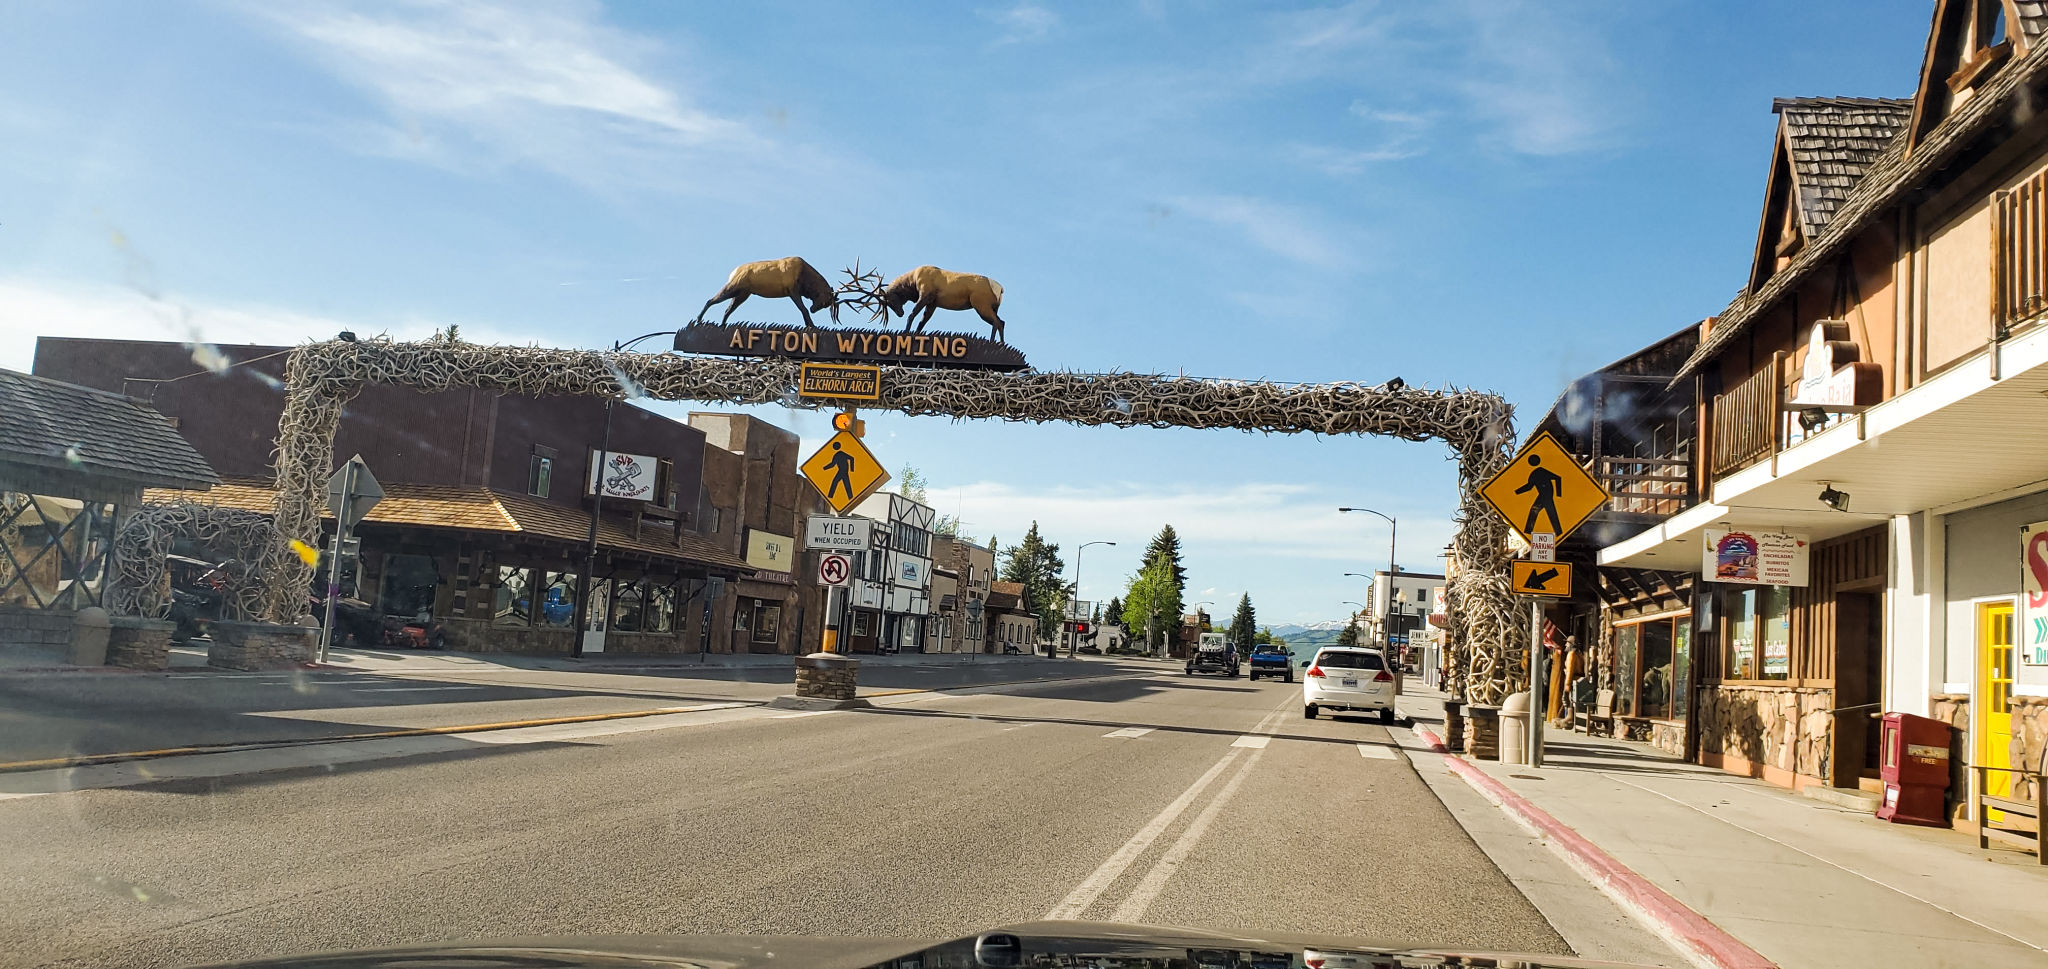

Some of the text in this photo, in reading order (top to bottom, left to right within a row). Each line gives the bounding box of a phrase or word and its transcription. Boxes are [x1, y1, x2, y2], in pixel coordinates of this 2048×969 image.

[730, 328, 967, 358] AFTON WYOMING
[810, 369, 871, 379] World's Largest
[805, 378, 874, 393] ELKHORN ARCH
[616, 454, 634, 466] SVP
[823, 522, 855, 535] YIELD
[814, 536, 861, 546] WHEN OCCUPIED
[1921, 757, 1936, 765] FREE
